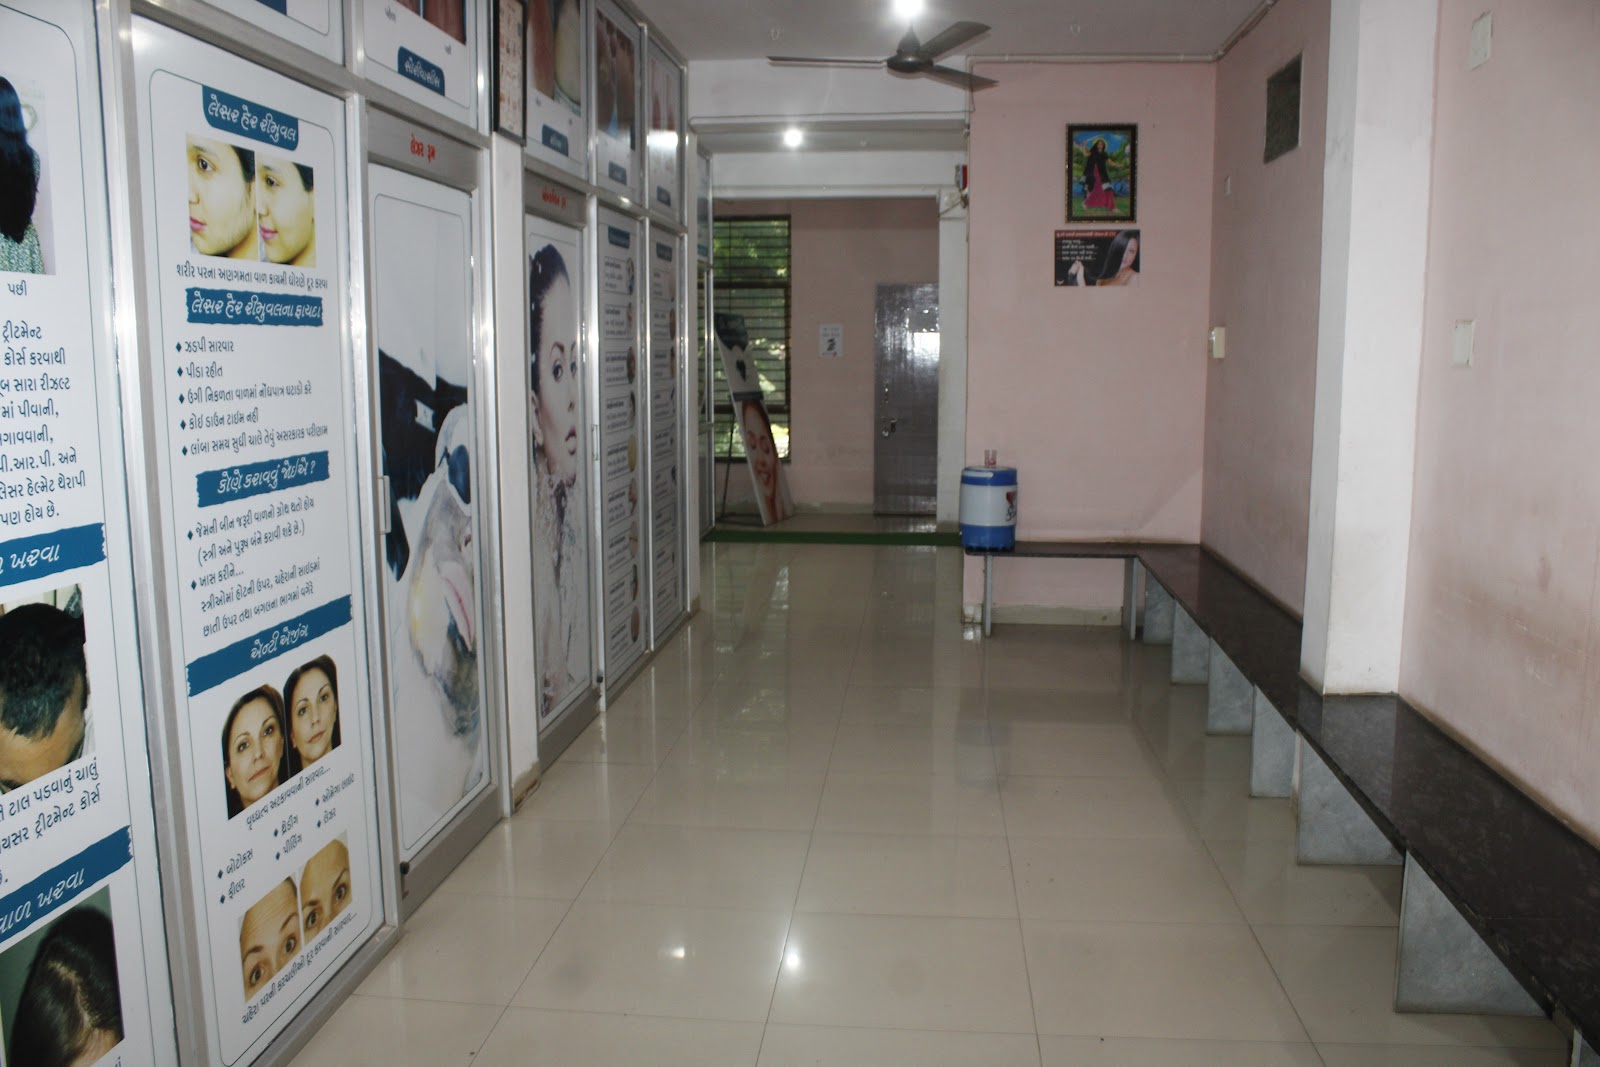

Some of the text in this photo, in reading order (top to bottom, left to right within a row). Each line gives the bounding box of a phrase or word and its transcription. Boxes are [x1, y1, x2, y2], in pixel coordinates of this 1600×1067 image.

[208, 93, 297, 142] લેસર હેર રીમુવલ
[176, 260, 195, 278] શરીર
[197, 265, 216, 279] પરના
[218, 268, 252, 282] અણગમતા
[254, 272, 267, 284] વાળ
[8, 280, 27, 296] પછી
[192, 290, 321, 323] લેસર હેર રીમુવલના ફાયદા
[2, 320, 42, 343] ટ્રીટમેન્ટ
[4, 346, 66, 366] કોર્સ કરવાથી
[184, 336, 234, 353] ઝડપી સારવાર
[186, 361, 223, 379] પીડા રહીત
[13, 378, 37, 392] સારા
[40, 372, 71, 391] રીઝલ્ટ
[205, 386, 234, 402] નિકળતા
[235, 384, 258, 399] વાળમાં
[304, 380, 312, 395] કરે
[18, 398, 59, 418] પીવાની,
[205, 411, 225, 427] ડાઉન
[190, 438, 209, 455] લાંબા
[212, 438, 230, 452] સમય
[232, 431, 247, 453] સુધી
[248, 429, 263, 445] ચાલે
[276, 427, 305, 441] અસરકારક
[58, 446, 77, 464] અને
[26, 475, 55, 496] હેલ્મેટ
[58, 469, 86, 490] થેરાપી
[217, 468, 243, 494] કોણે
[243, 463, 281, 489] કરાવવું
[310, 460, 316, 474] ?
[0, 499, 60, 526] પણ હોય છે.
[196, 518, 218, 538] જેમની
[219, 515, 235, 531] બીન
[218, 538, 233, 556] અને
[263, 525, 281, 544] કરાવી
[10, 544, 60, 569] ખરવા
[199, 572, 216, 587] ખાસ
[203, 616, 221, 637] છાતી
[222, 614, 237, 629] ઉપર
[250, 630, 278, 659] એન્ટી
[9, 795, 30, 817] ટાલ
[33, 769, 74, 802] પડવાનું
[75, 756, 99, 781] ચાલું
[0, 827, 29, 849] યસર
[35, 802, 76, 839] ટ્રીટમેન્ટ
[80, 783, 101, 810] કોર્સ
[37, 868, 85, 908] ખરવા
